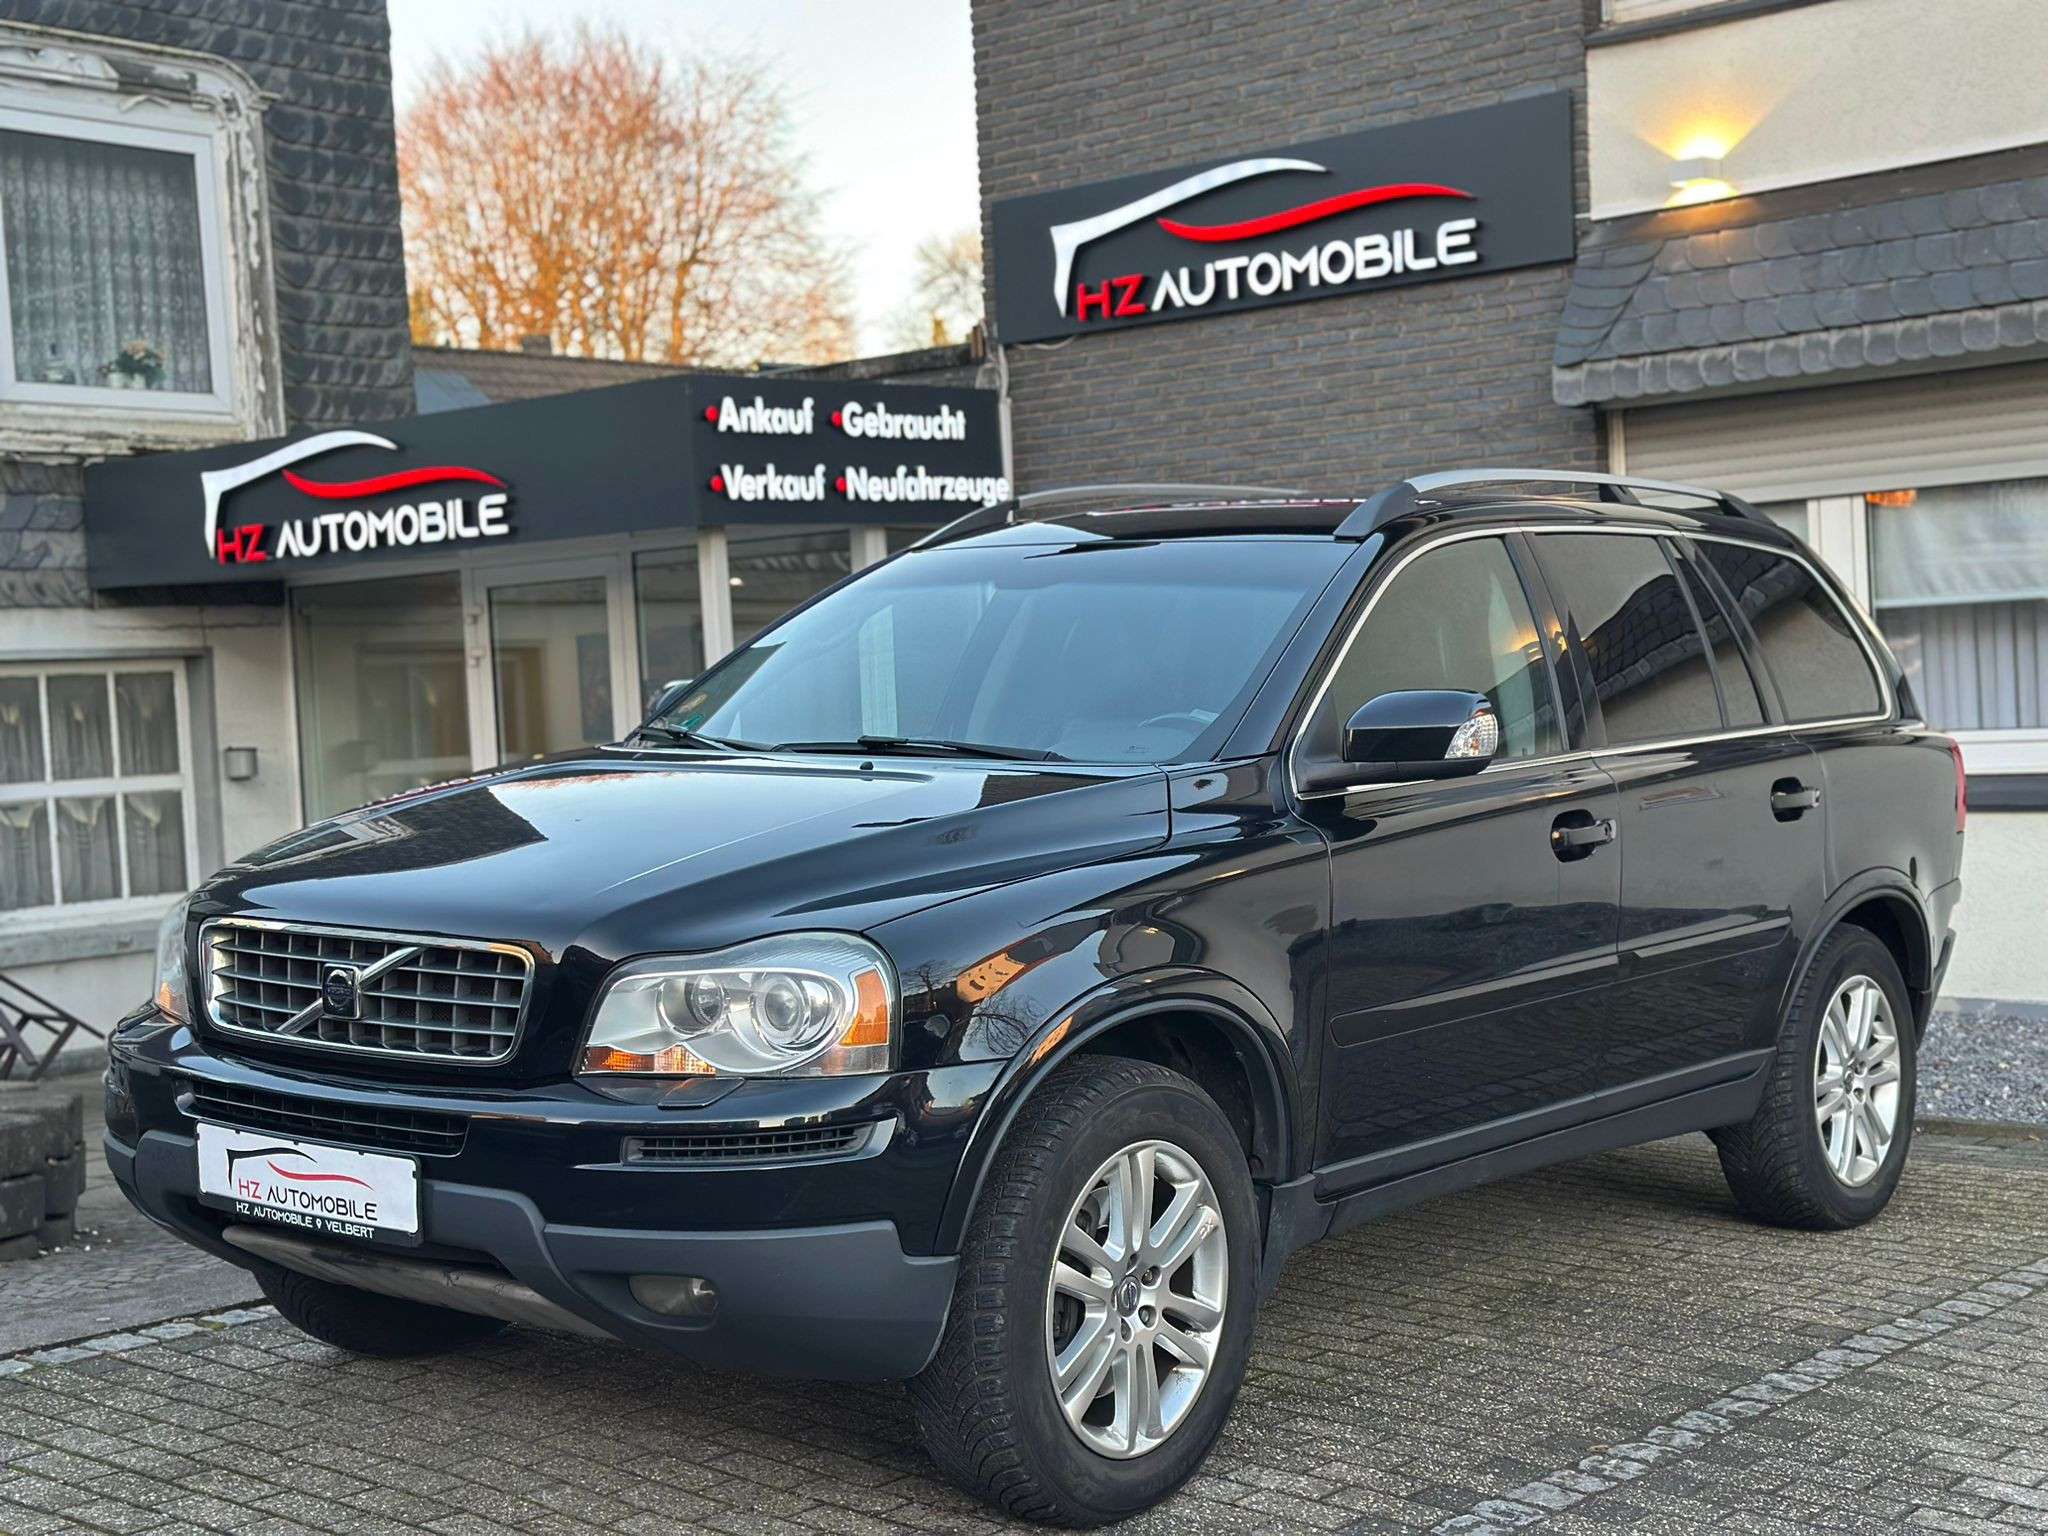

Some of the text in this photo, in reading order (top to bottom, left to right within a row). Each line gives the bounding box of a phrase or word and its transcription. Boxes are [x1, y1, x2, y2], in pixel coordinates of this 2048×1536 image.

[1076, 217, 1478, 321] HZ AUTOMOBILE
[718, 396, 966, 440] Ankauf Gebraucht
[720, 463, 1010, 507] Verkauf Neufahrzeuge
[217, 493, 509, 565] HZ AUTOMOBILE
[236, 1201, 375, 1239] HZ AUTOMOBILE VELBERT
[238, 1178, 378, 1221] HZ AUTOMOBILE
